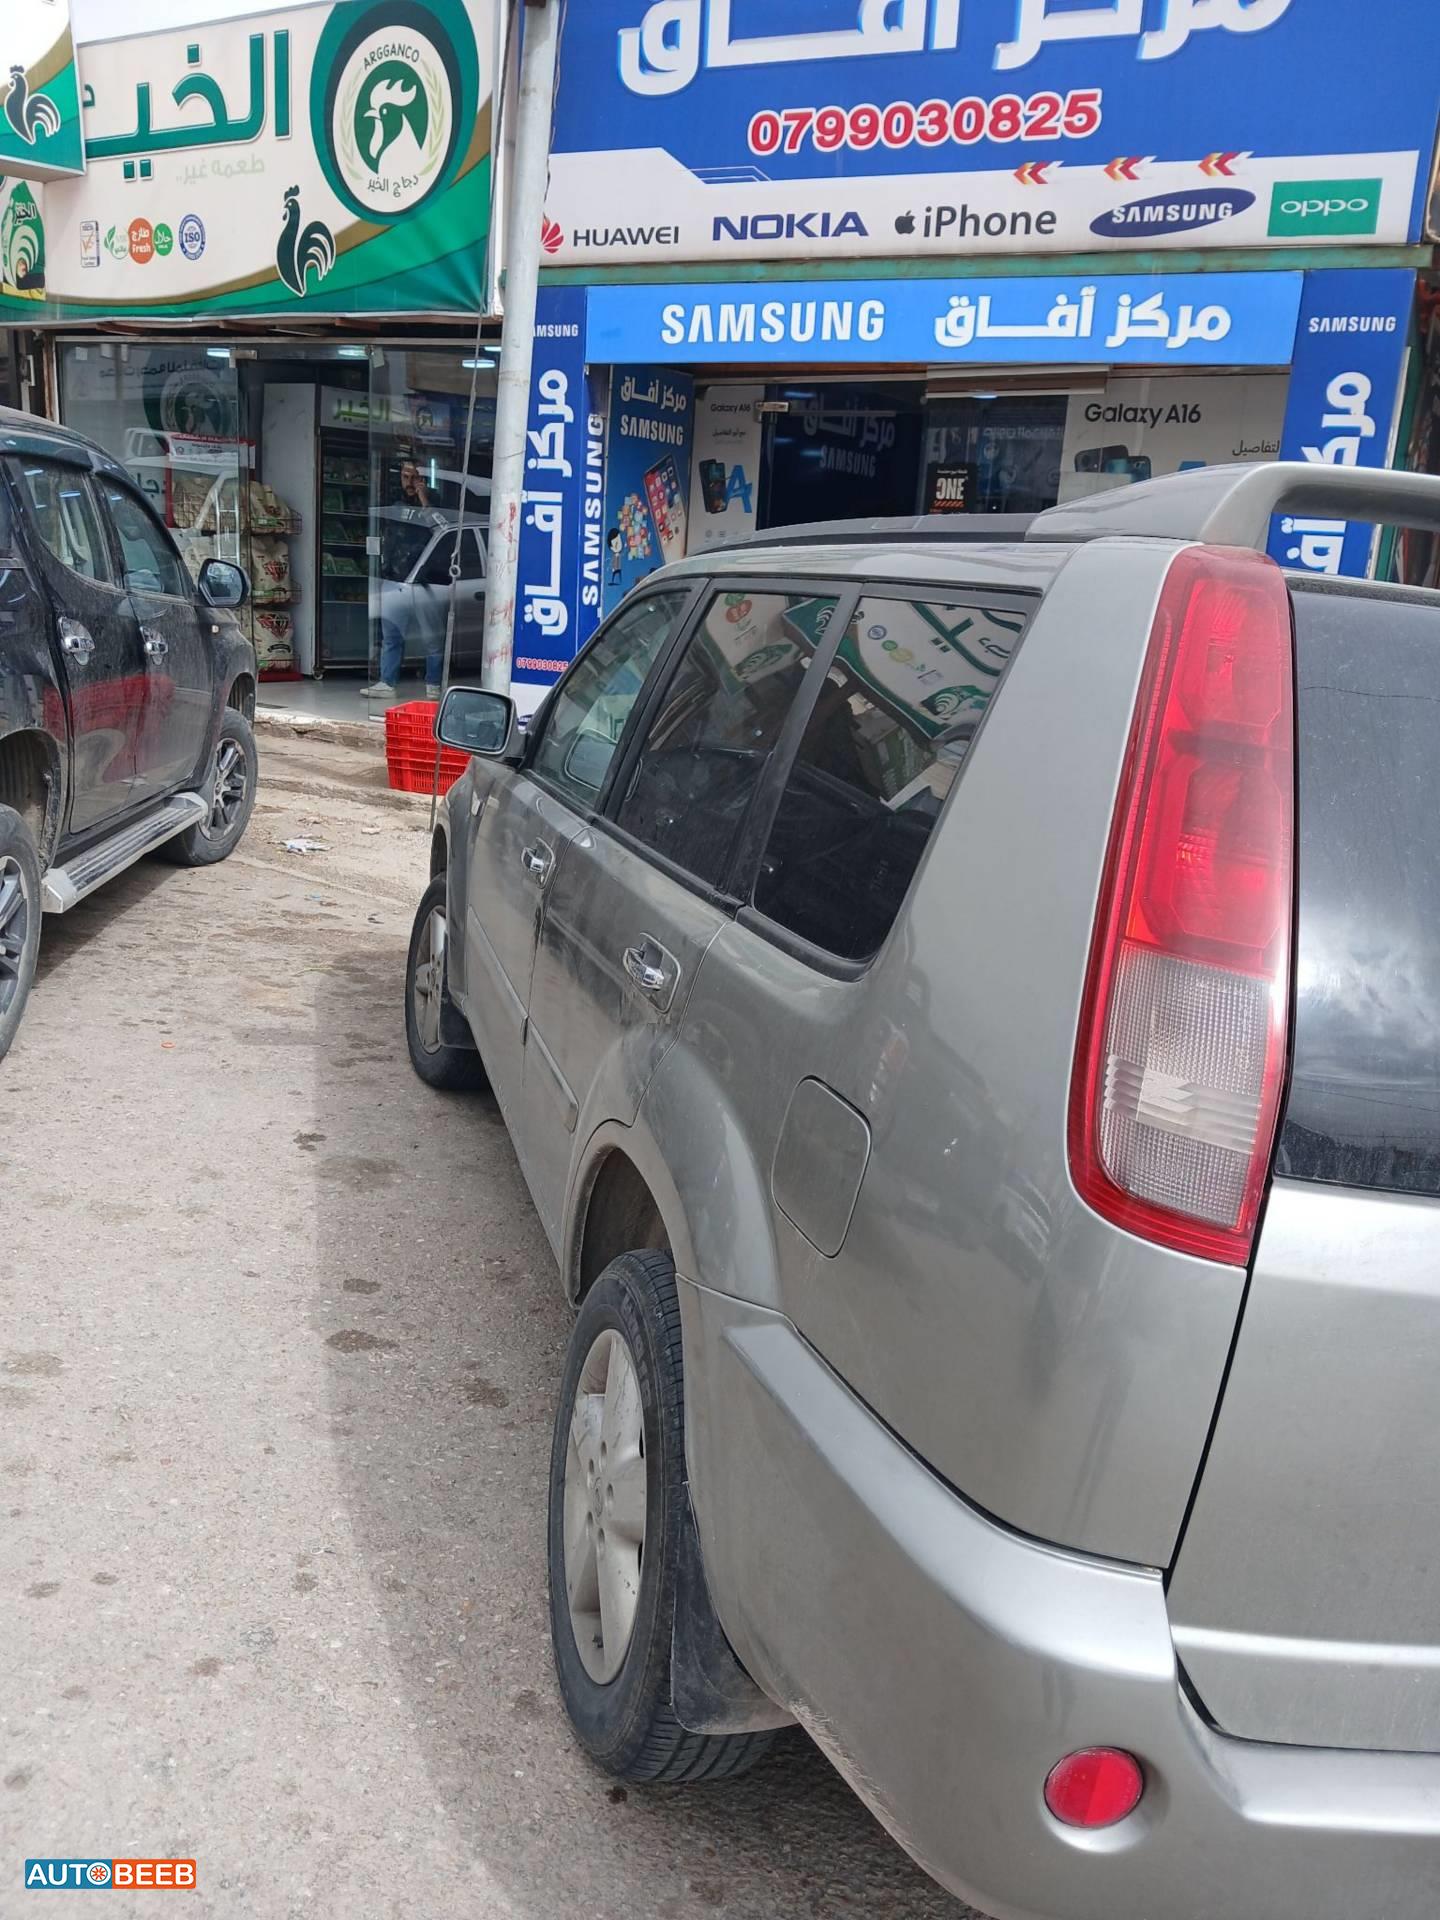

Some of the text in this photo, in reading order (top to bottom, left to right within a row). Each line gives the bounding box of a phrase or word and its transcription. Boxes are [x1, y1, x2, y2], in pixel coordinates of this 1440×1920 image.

[363, 43, 420, 70] ARGGANCO
[85, 29, 290, 182] الخي
[749, 90, 1101, 155] 0799030825
[368, 177, 389, 192] الخير
[184, 232, 200, 243] ISO
[573, 226, 680, 248] HUAWEI
[712, 211, 869, 242] NOKIA
[923, 204, 1057, 237] iPhone
[1111, 202, 1233, 225] SAMSUNG
[131, 243, 152, 254] Fresh
[534, 323, 579, 338] MSUNG
[660, 299, 886, 344] SAMSUNG
[1104, 291, 1232, 349] مركز
[1308, 316, 1396, 334] SAMSUNG
[660, 385, 687, 413] مركز
[527, 369, 574, 478] مركز
[620, 414, 684, 446] SAMSUNG
[1084, 403, 1202, 429] Galaxy A16
[1301, 371, 1376, 467] مرك
[820, 444, 877, 478] SAMSUNG
[1231, 440, 1280, 456] لتفاصيل
[582, 413, 606, 606] SAMSUNG
